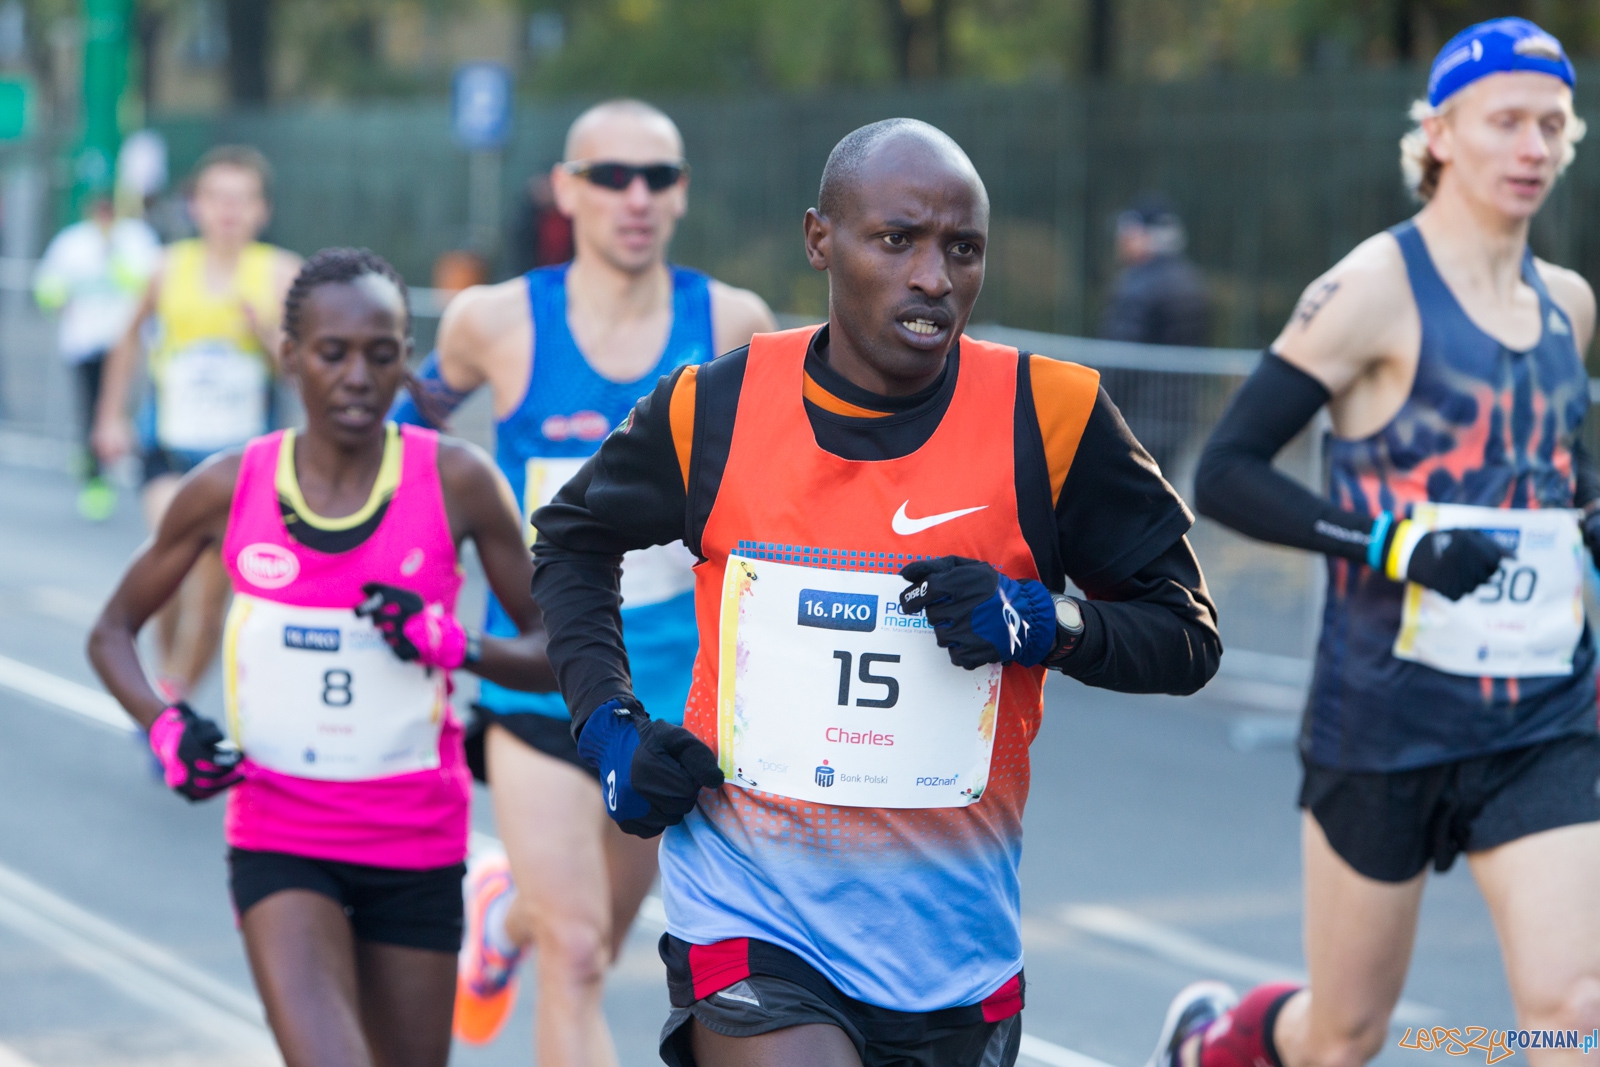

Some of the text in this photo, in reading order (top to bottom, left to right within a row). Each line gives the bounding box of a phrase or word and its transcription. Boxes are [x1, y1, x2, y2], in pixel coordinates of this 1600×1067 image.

[804, 600, 871, 621] 16. PKO
[322, 669, 353, 707] 8
[833, 650, 901, 709] 15
[825, 727, 895, 747] Charles
[840, 773, 889, 785] Bank Polski
